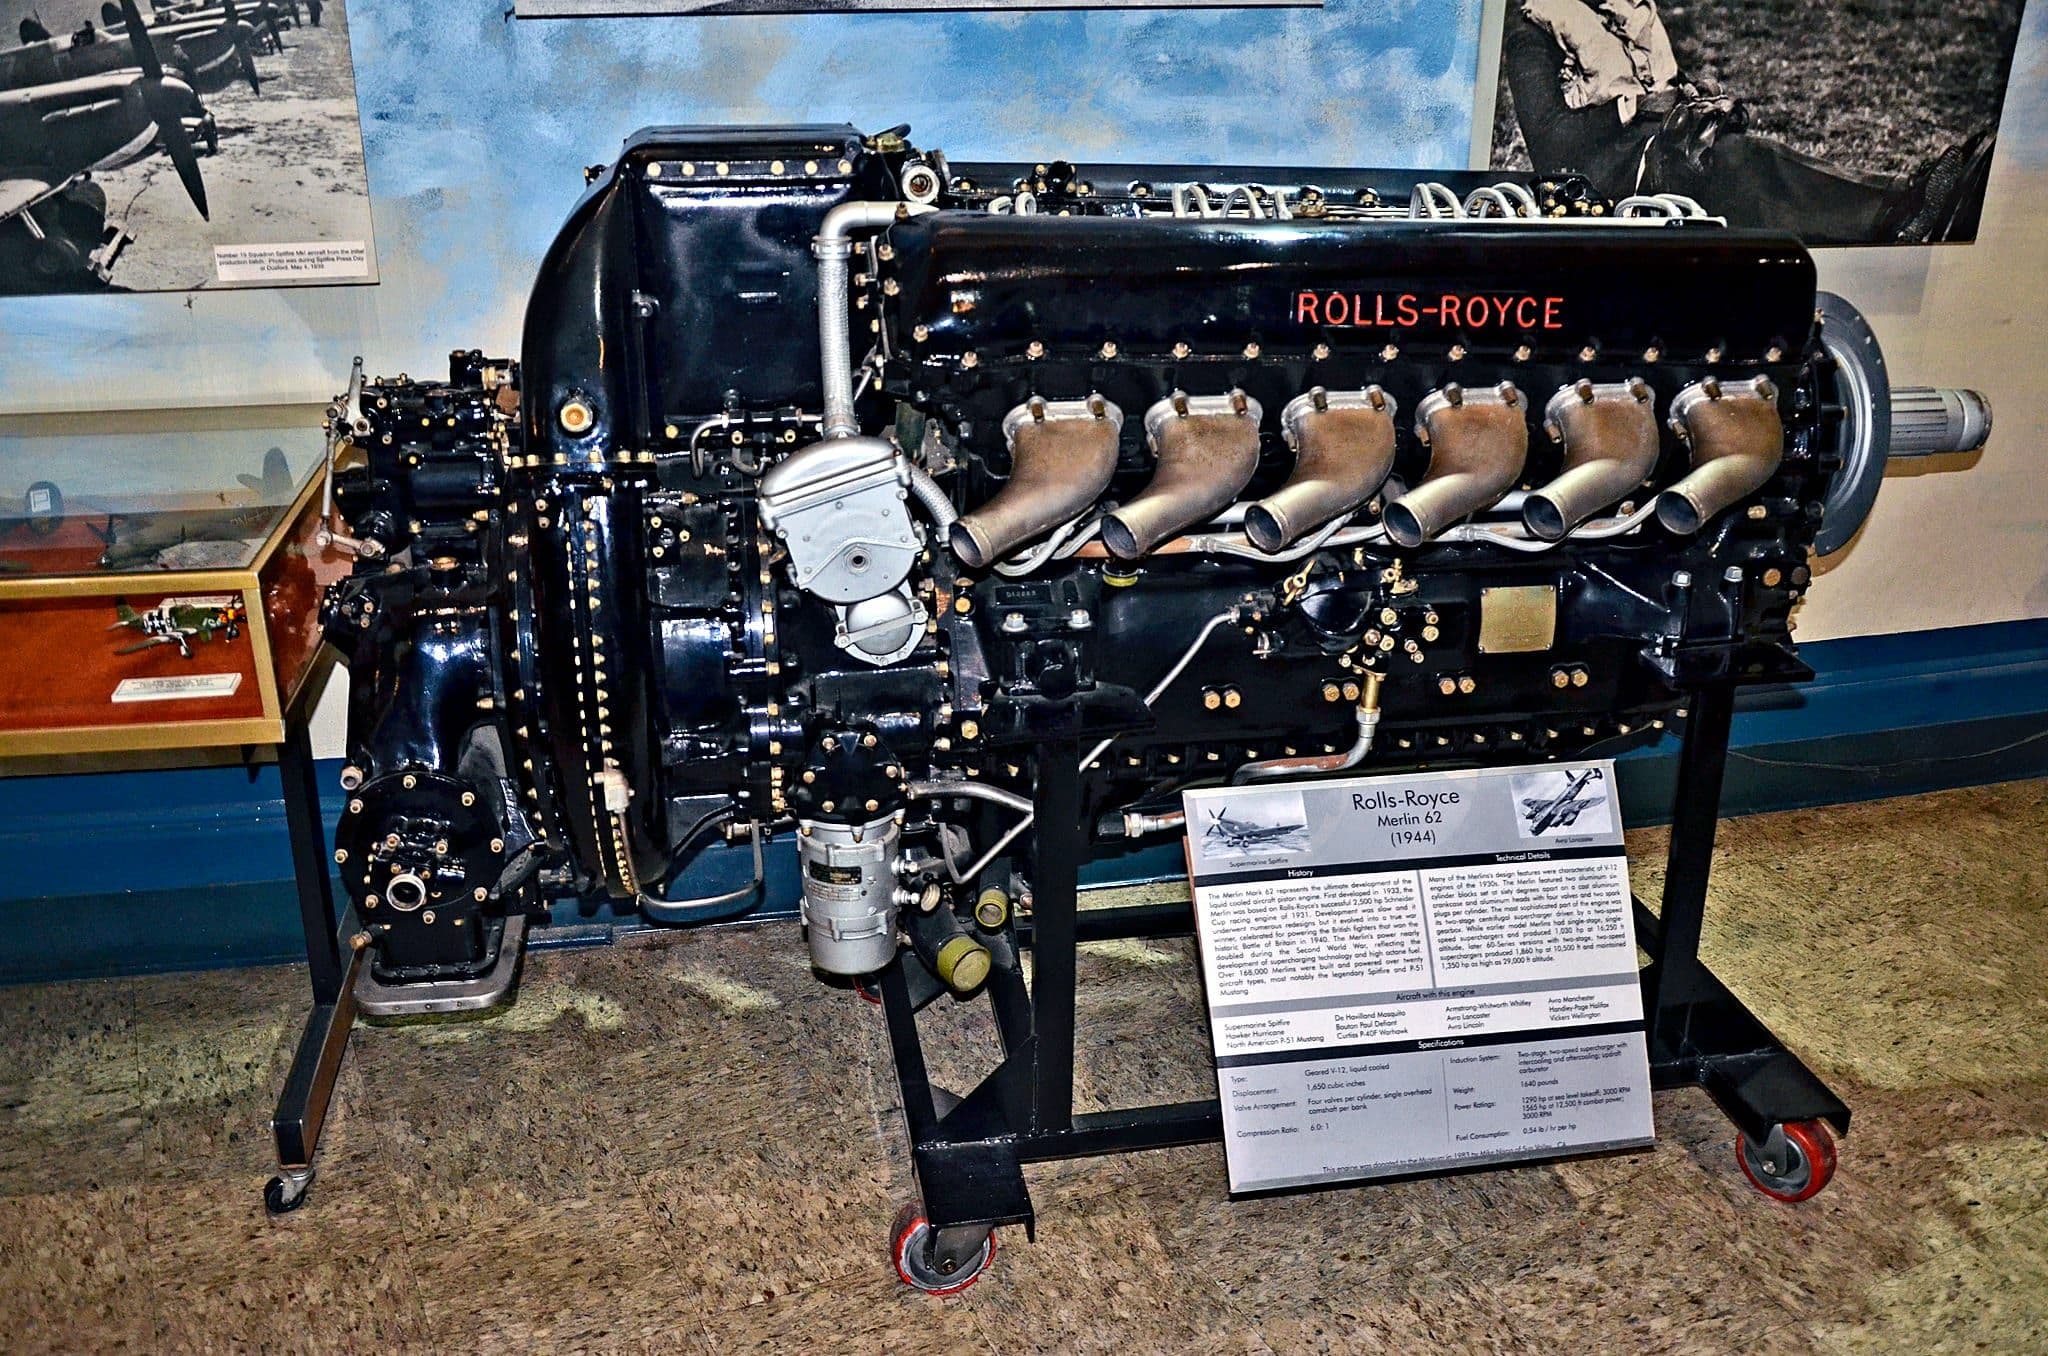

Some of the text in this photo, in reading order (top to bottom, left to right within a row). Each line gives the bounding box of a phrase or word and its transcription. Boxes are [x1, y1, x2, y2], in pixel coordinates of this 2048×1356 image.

[1297, 292, 1563, 328] ROLLS-ROYCE
[1351, 788, 1460, 810] Rolls-Royce
[1376, 810, 1442, 827] Merlin 62
[1390, 829, 1435, 847] (1944)
[1496, 850, 1549, 862] Technical Details
[1288, 869, 1313, 878] History
[1495, 871, 1515, 879] design
[1558, 865, 1594, 873] characteristic
[1276, 886, 1308, 895] represents
[1350, 880, 1391, 888] development
[1209, 900, 1227, 909] liquid
[1229, 898, 1250, 906] cooled
[1277, 896, 1296, 904] piston
[1338, 889, 1370, 898] developed
[1279, 902, 1318, 911] Rolls-Royce's
[1320, 900, 1351, 908] successful
[1384, 895, 1413, 903] Schneider
[1395, 991, 1424, 1000] Aircraft
[1452, 987, 1475, 997] engine
[1562, 994, 1594, 1002] Manchester
[1445, 999, 1531, 1012] Armstrong-Whitworth Whitley
[1549, 1003, 1588, 1012] Handley-Page
[1345, 1011, 1375, 1020] Havilland
[1376, 1009, 1405, 1018] Mosquito
[1550, 1011, 1600, 1021] Vickers Wellington
[1223, 1018, 1290, 1031] Supermarine Spitfire
[1463, 1020, 1483, 1028] Lincoln
[1224, 1029, 1285, 1039] Hawker Hurricane
[1336, 1031, 1358, 1039] Curtiss
[1378, 1026, 1407, 1035] Warhawk
[1227, 1040, 1244, 1048] North
[1247, 1038, 1278, 1046] American
[1417, 1038, 1464, 1050] Specifications
[1449, 1055, 1478, 1063] Induction
[1304, 1068, 1329, 1076] Geared
[1349, 1064, 1367, 1074] liquid
[1369, 1062, 1389, 1070] cooled
[1327, 1081, 1344, 1089] cubic
[1345, 1079, 1365, 1087] inches
[1537, 1077, 1557, 1087] pounds
[1383, 1090, 1402, 1099] single
[1402, 1087, 1432, 1096] overhead
[1538, 1095, 1546, 1103] hp
[1308, 1102, 1366, 1114] camshaft per bank
[1538, 1103, 1547, 1111] hp
[1583, 1097, 1604, 1105] combat
[1235, 1127, 1280, 1138] Compression
[1568, 1123, 1576, 1131] hp
